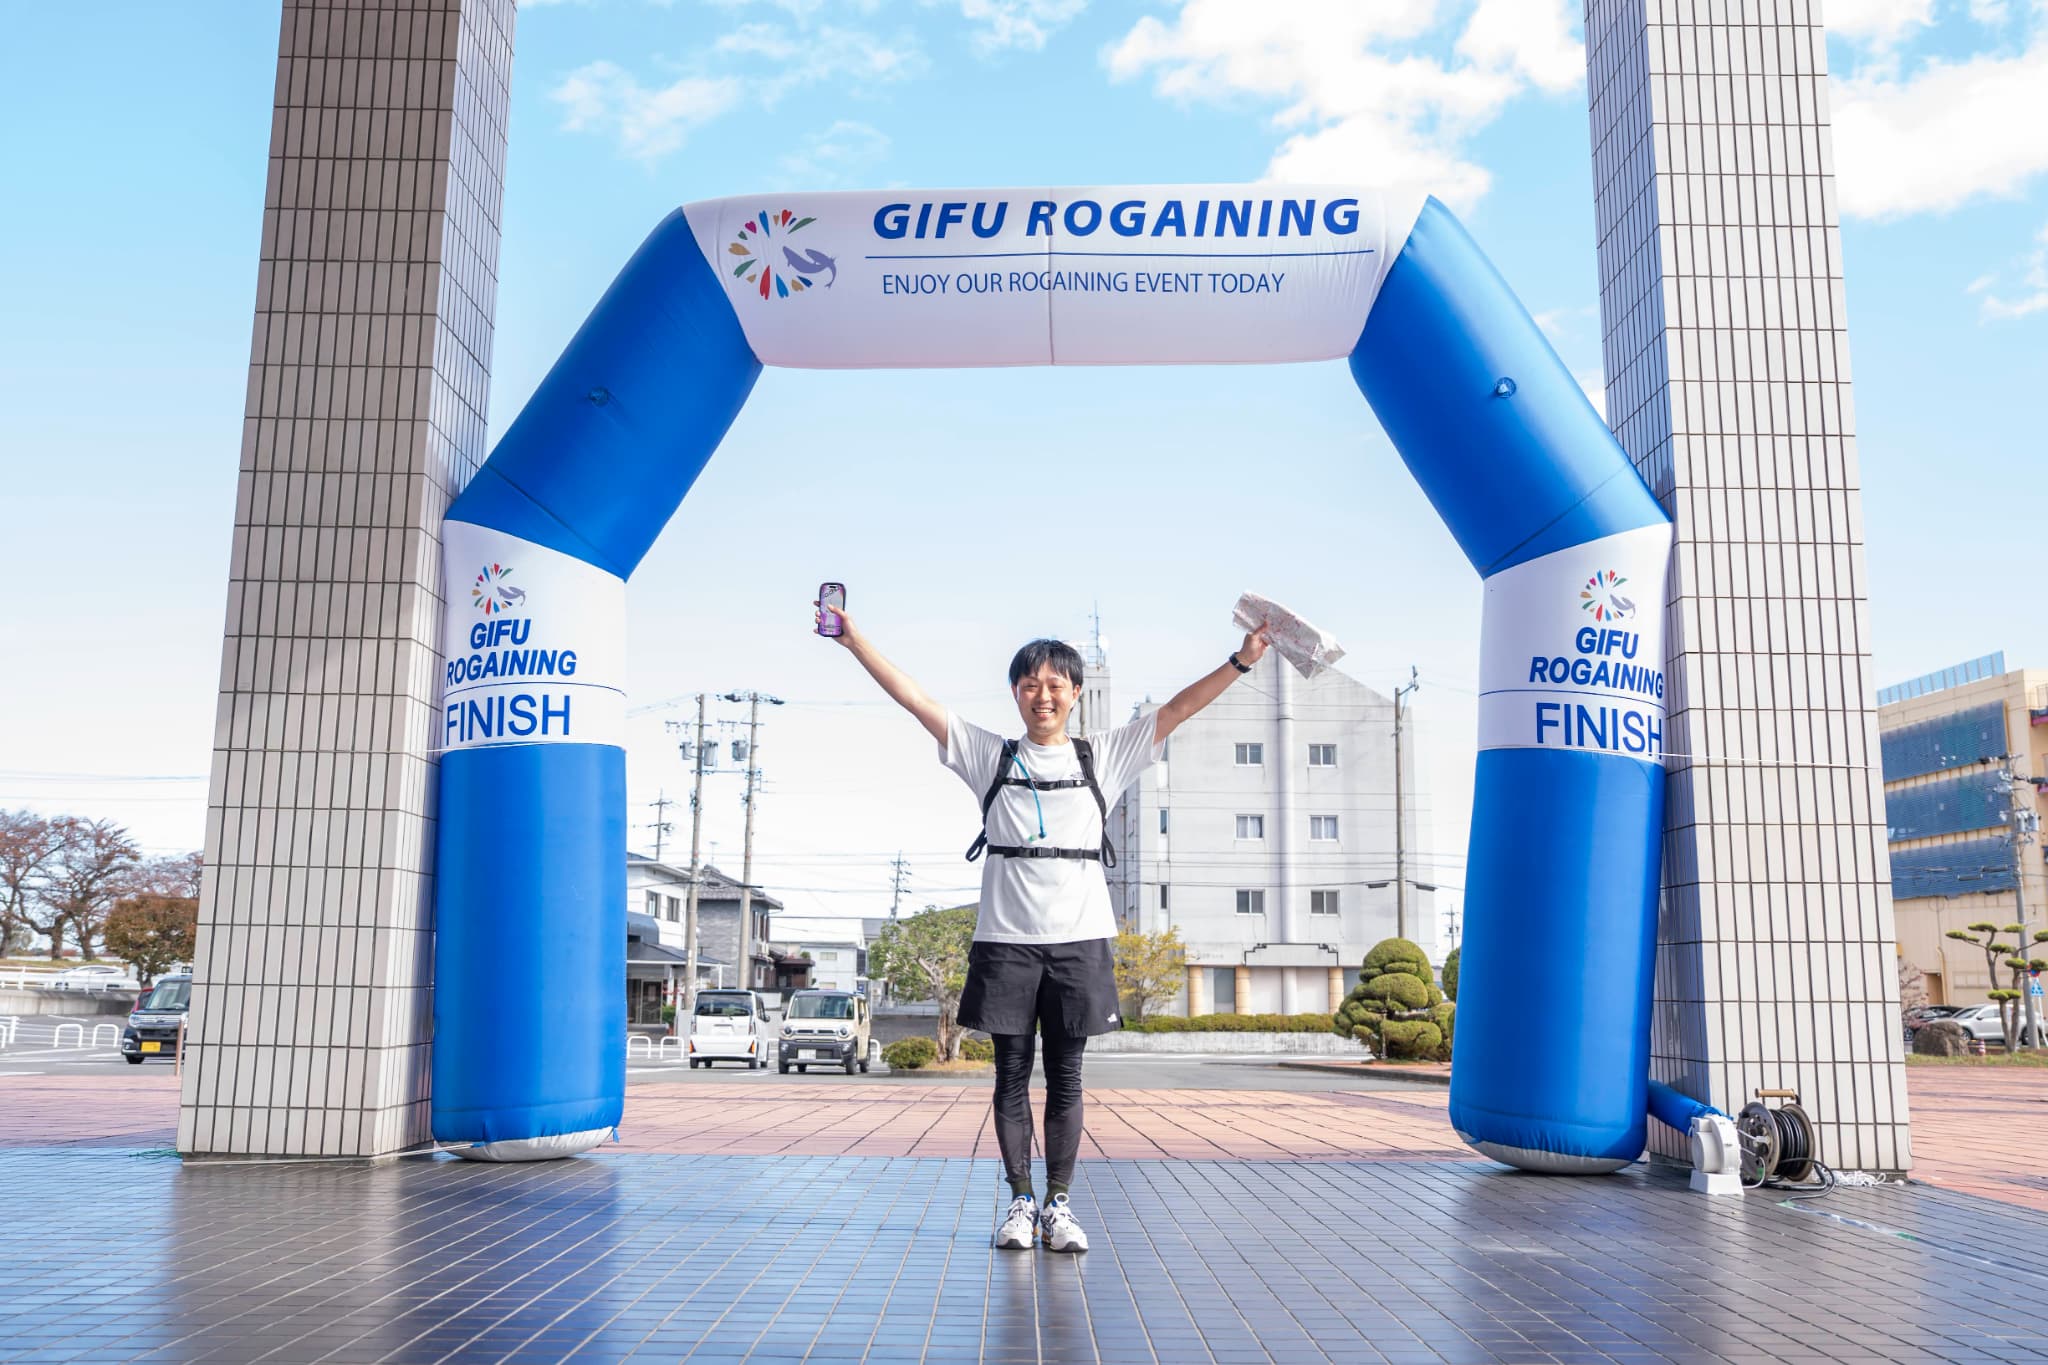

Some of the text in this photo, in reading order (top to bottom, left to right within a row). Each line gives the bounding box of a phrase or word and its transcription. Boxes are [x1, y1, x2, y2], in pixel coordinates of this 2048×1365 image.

[873, 198, 1360, 240] GIFU ROGAINING
[881, 271, 1285, 296] ENJOY OUR ROGAINING EVENT TODAY
[470, 618, 532, 650] GIFU
[1575, 626, 1639, 660] GIFU
[446, 649, 577, 688] ROGAINING
[1529, 656, 1664, 699] ROGAINING
[446, 694, 571, 746] FINISH
[1535, 702, 1663, 760] FINISH
